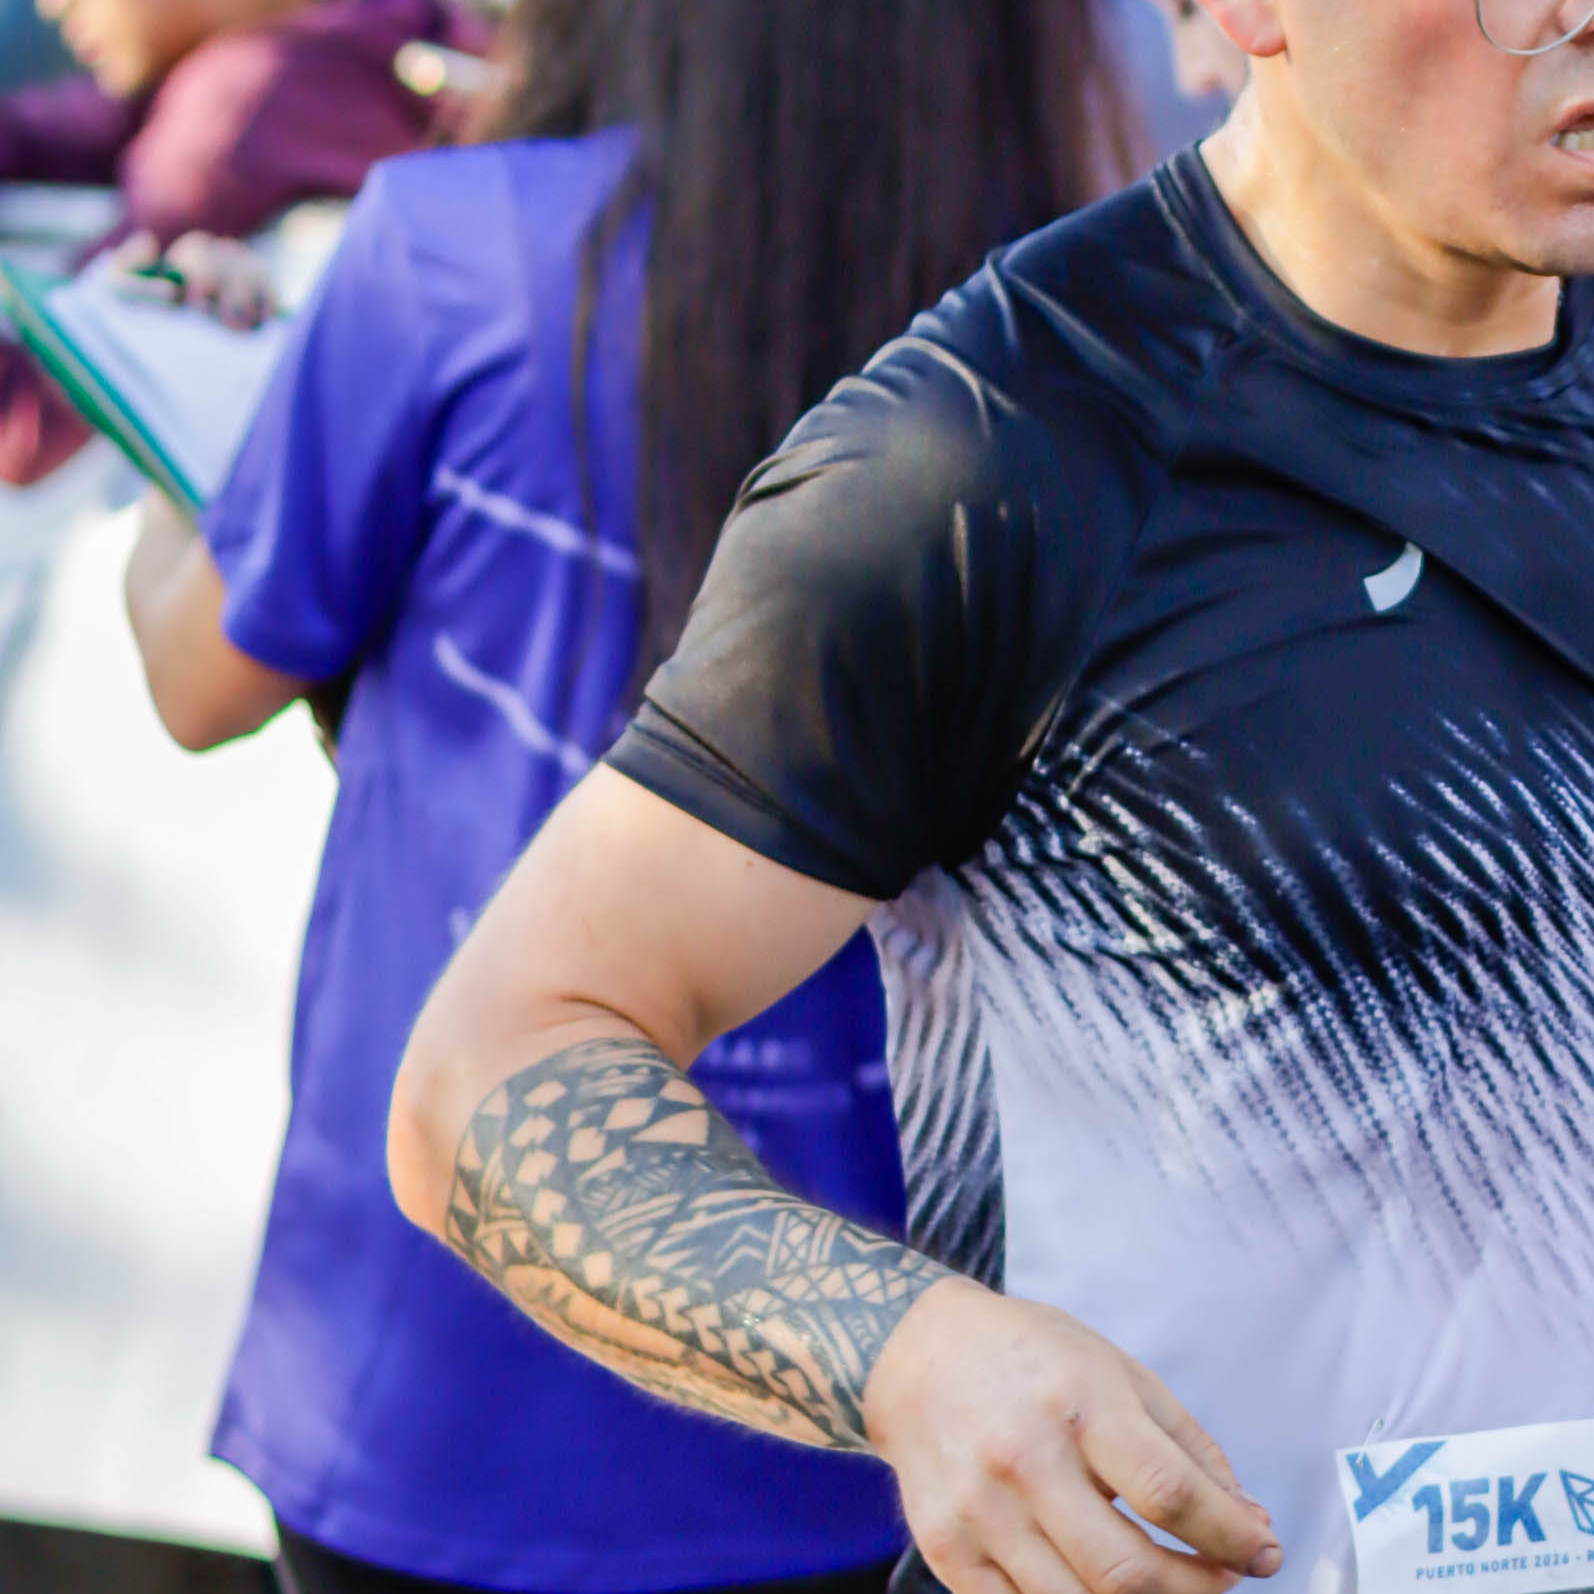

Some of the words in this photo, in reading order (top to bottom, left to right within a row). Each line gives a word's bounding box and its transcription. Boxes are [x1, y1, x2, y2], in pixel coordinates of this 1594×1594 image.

[1412, 1471, 1548, 1554] 15K
[1416, 1562, 1475, 1581] PUERTO
[1480, 1556, 1528, 1574] NORTE
[1534, 1553, 1570, 1568] 2026
